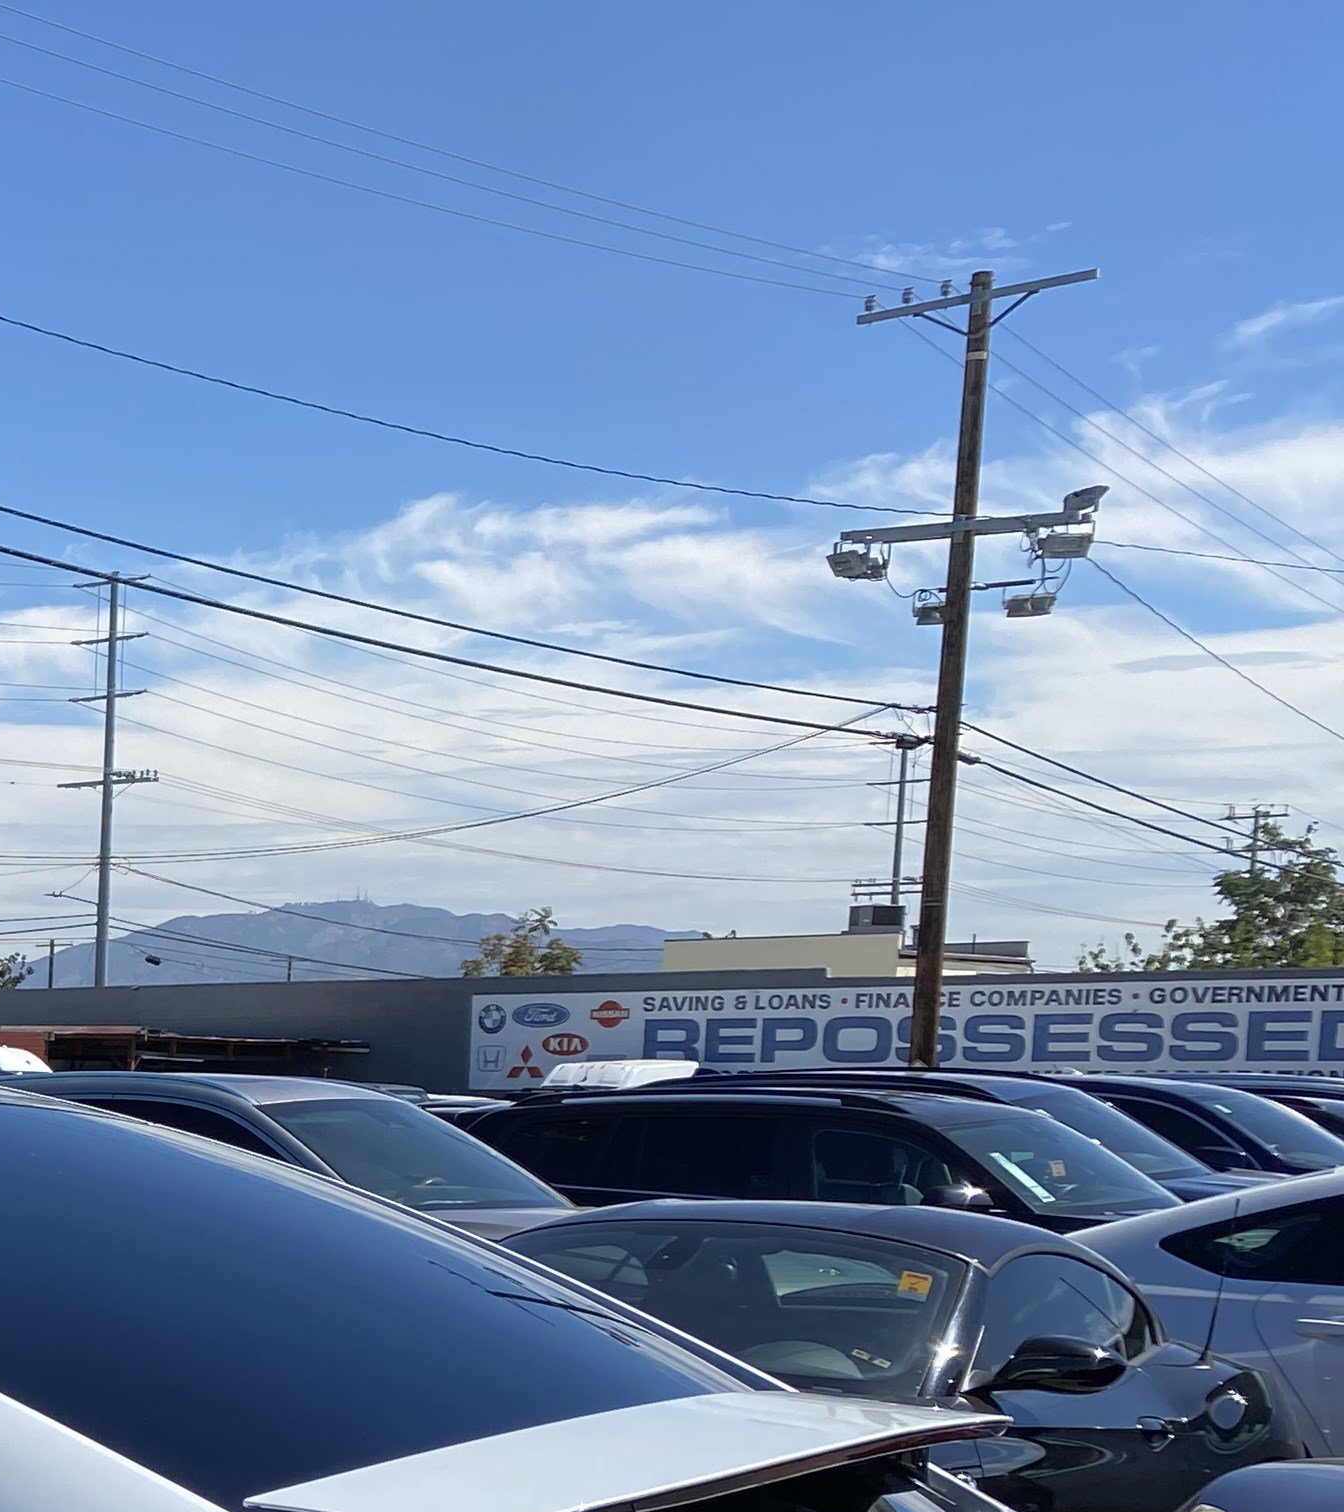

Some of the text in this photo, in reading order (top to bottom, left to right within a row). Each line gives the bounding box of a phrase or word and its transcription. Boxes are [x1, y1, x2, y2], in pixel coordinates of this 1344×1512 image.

[642, 995, 724, 1012] SAVING
[734, 995, 747, 1010] &
[754, 992, 831, 1010] LOANS
[855, 990, 961, 1009] FINAE
[969, 988, 1122, 1008] COMPANIES
[524, 1007, 558, 1022] Ford
[548, 1037, 582, 1051] KIA
